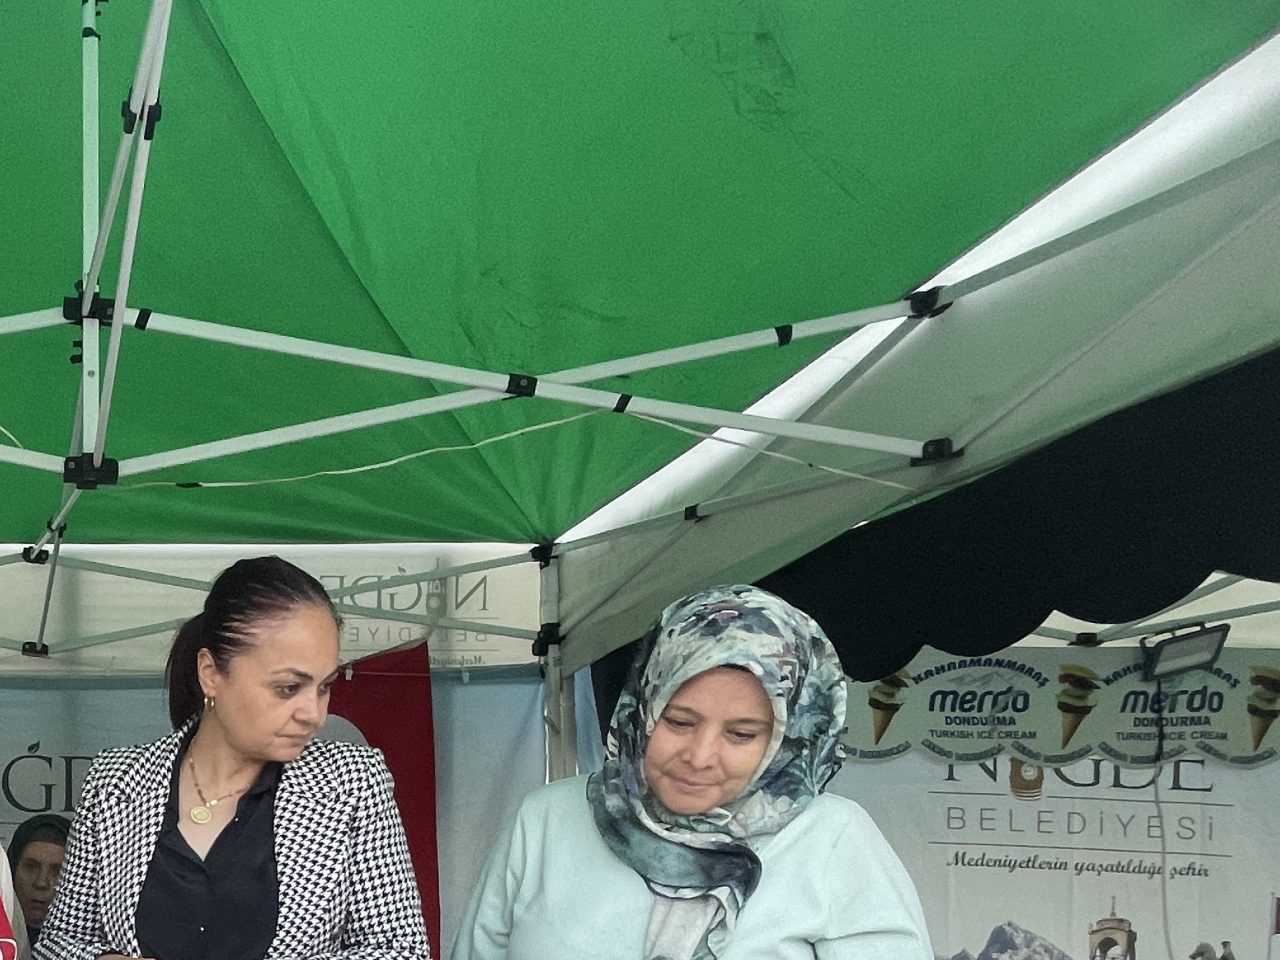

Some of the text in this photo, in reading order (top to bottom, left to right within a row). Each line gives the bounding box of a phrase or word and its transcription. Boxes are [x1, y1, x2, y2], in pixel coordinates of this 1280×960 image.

[928, 685, 1030, 713] merdo
[1119, 685, 1225, 713] merdo
[928, 730, 975, 739] TURKISH
[998, 730, 1038, 739] CREAM
[1191, 730, 1229, 741] CREAM
[946, 806, 1214, 841] BELEDİYESİ
[946, 850, 1069, 873] Medeniyetlerin
[1168, 861, 1210, 879] şehir
